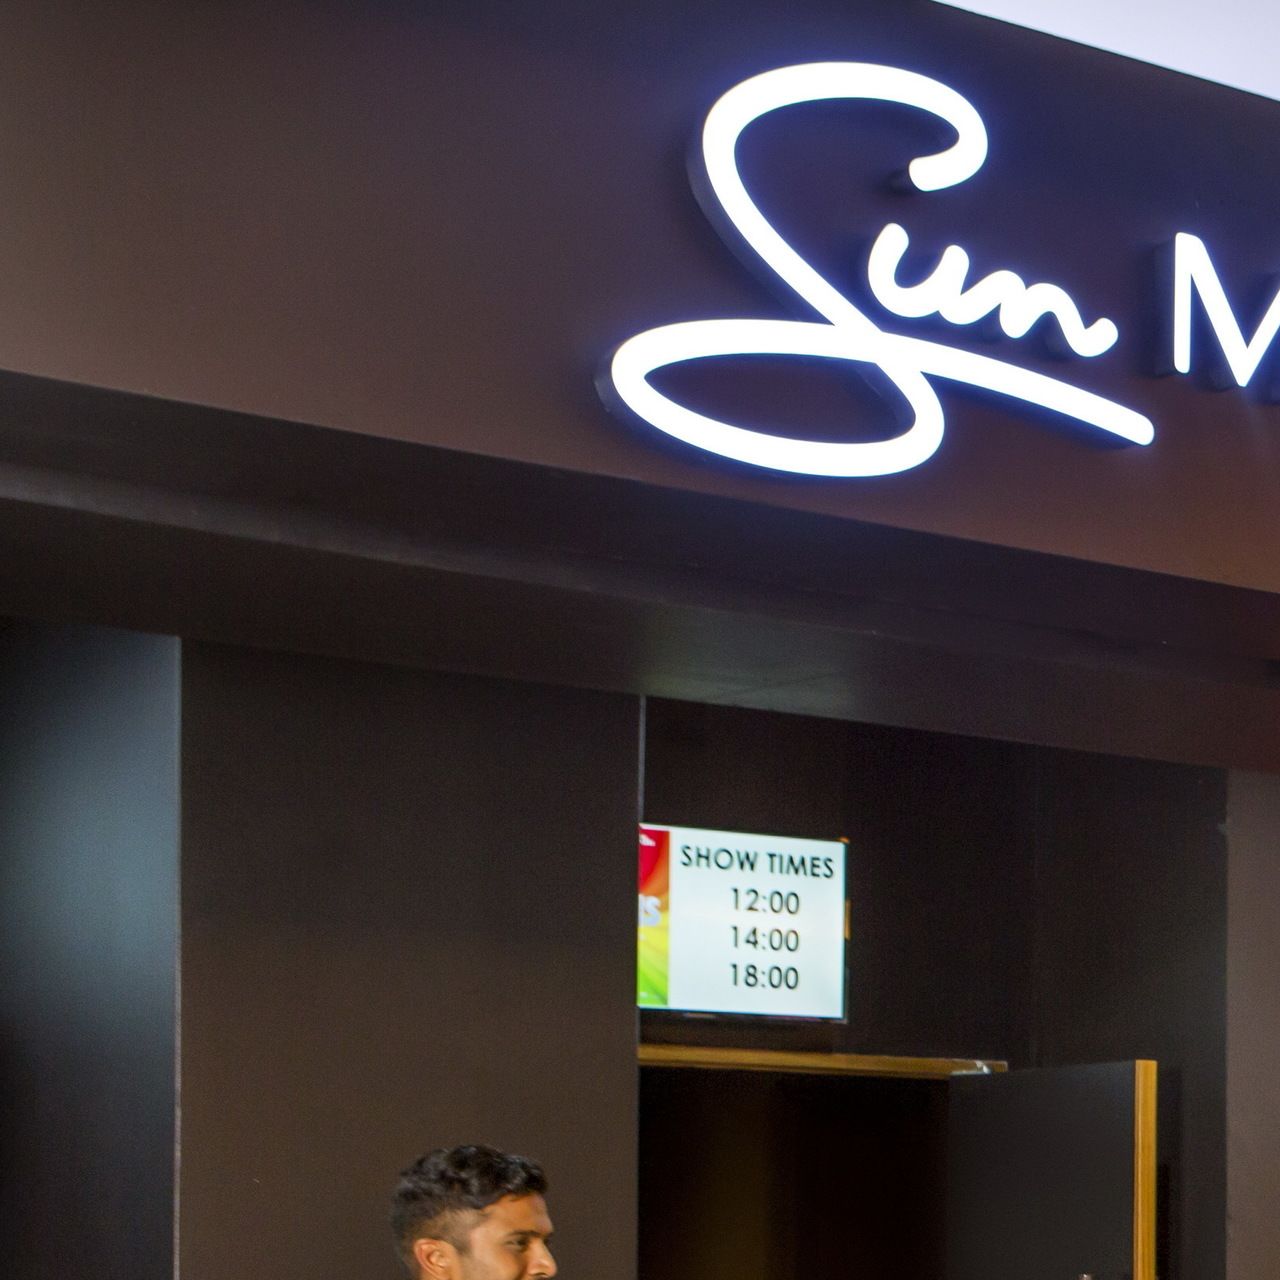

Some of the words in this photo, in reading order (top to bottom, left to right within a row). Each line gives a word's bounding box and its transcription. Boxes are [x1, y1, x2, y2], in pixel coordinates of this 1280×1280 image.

[611, 61, 1154, 477] Sun
[680, 845, 758, 872] SHOW
[767, 851, 834, 879] TIMES
[732, 887, 800, 915] 12:00
[731, 925, 800, 952] 14:00
[730, 963, 800, 990] 18:00
